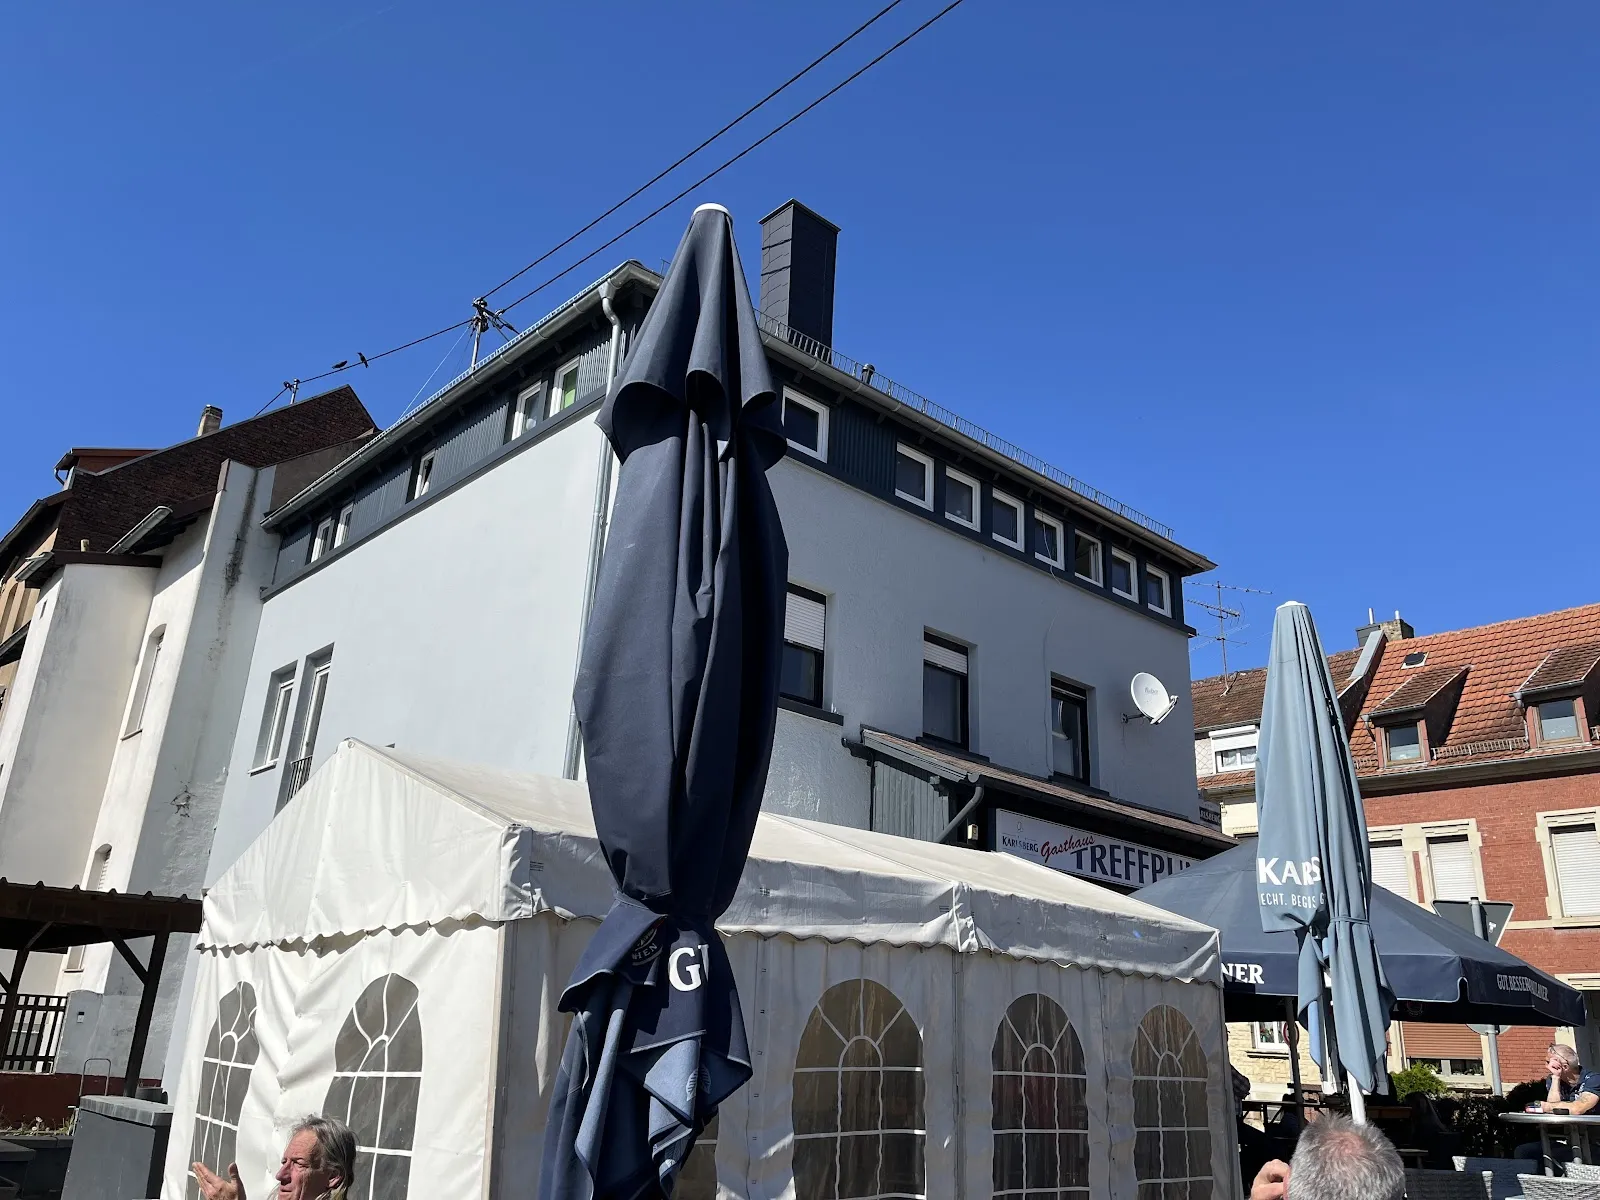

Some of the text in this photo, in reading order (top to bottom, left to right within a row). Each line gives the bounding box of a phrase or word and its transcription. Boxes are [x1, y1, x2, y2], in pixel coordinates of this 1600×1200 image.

[1002, 835, 1039, 853] KARLSBERG
[1040, 834, 1096, 863] Gasthaus
[1070, 845, 1190, 883] TREFFP
[1260, 892, 1288, 906] ECHT.
